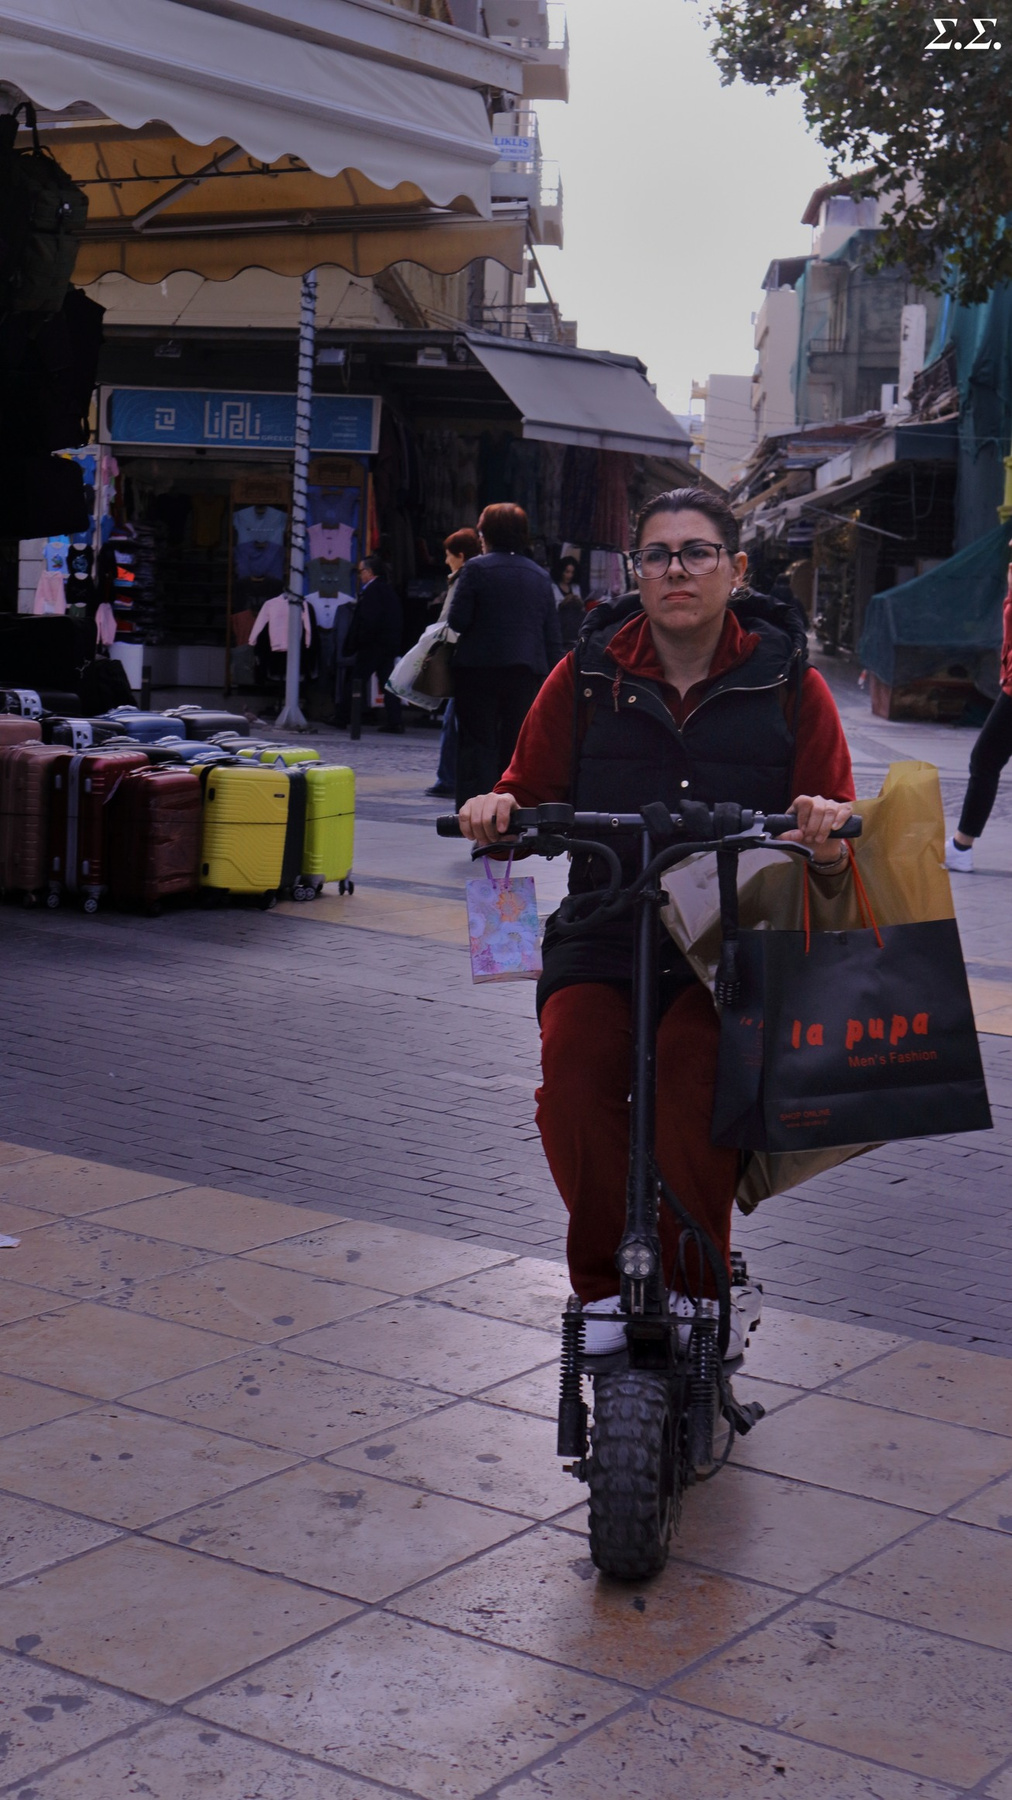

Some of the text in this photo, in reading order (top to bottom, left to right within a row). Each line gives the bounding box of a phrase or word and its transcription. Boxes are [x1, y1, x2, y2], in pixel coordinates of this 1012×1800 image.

[791, 1012, 929, 1050] la pupa
[848, 1050, 938, 1068] Men's Fashion
[779, 1108, 832, 1121] SHOP ONLINE
